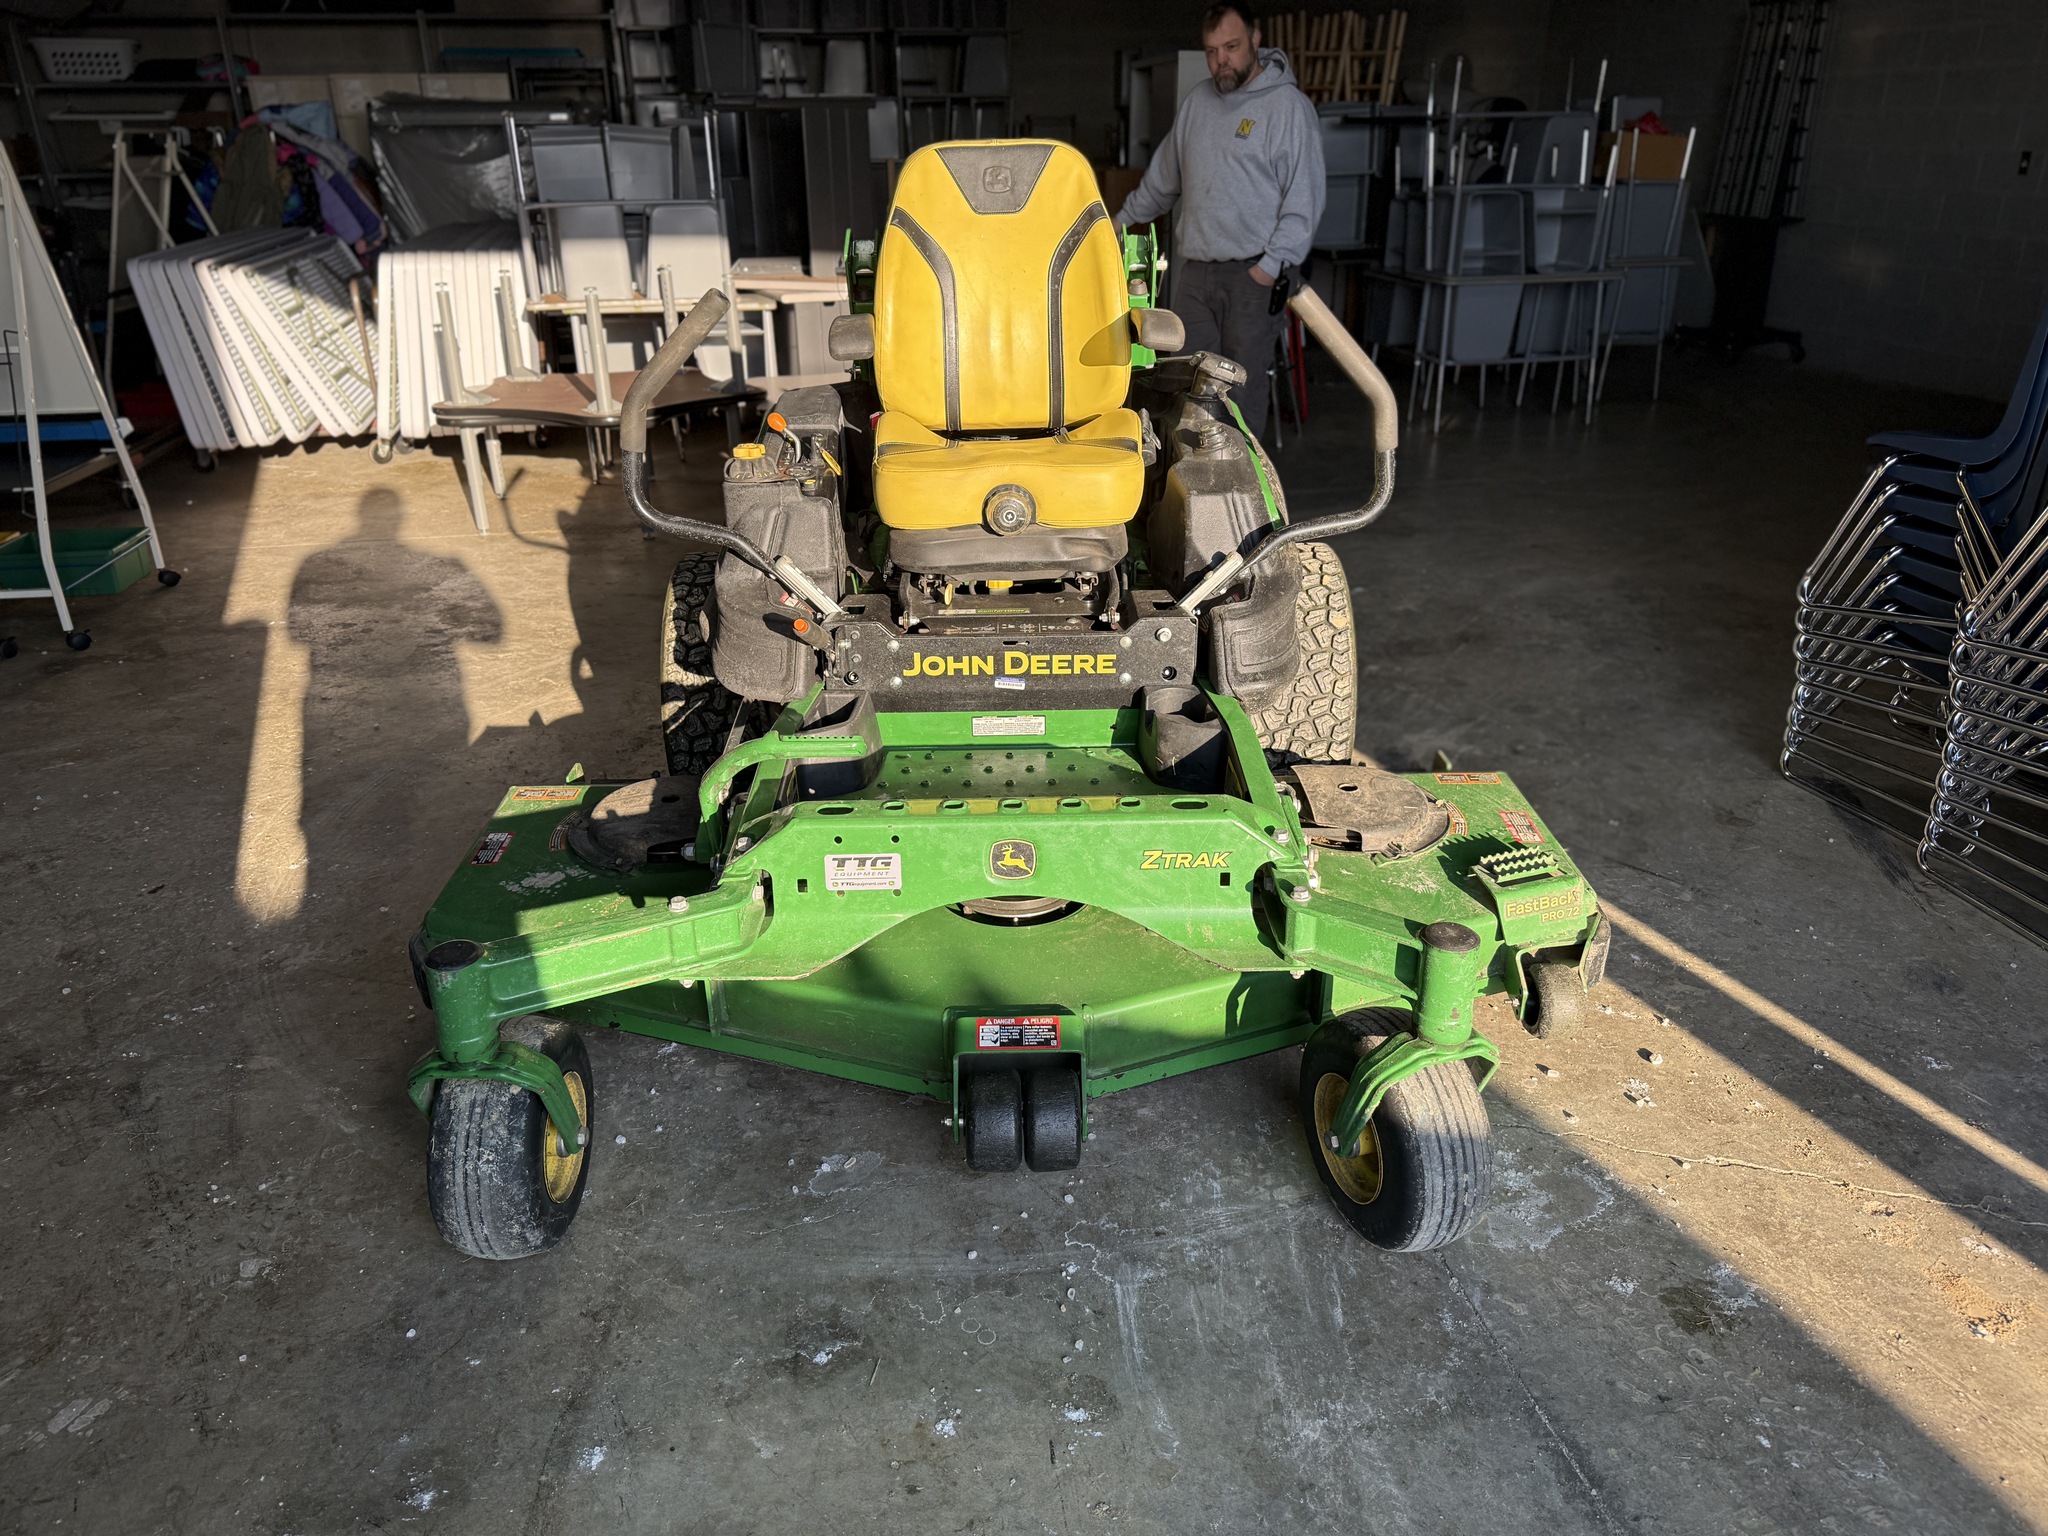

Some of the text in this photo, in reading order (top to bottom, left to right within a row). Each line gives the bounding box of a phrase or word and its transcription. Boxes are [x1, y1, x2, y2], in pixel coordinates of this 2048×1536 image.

[903, 651, 1117, 676] JOHN DEERE
[832, 856, 893, 870] TTG
[1140, 849, 1233, 870] ZTRAK
[1541, 906, 1580, 923] PRO 72
